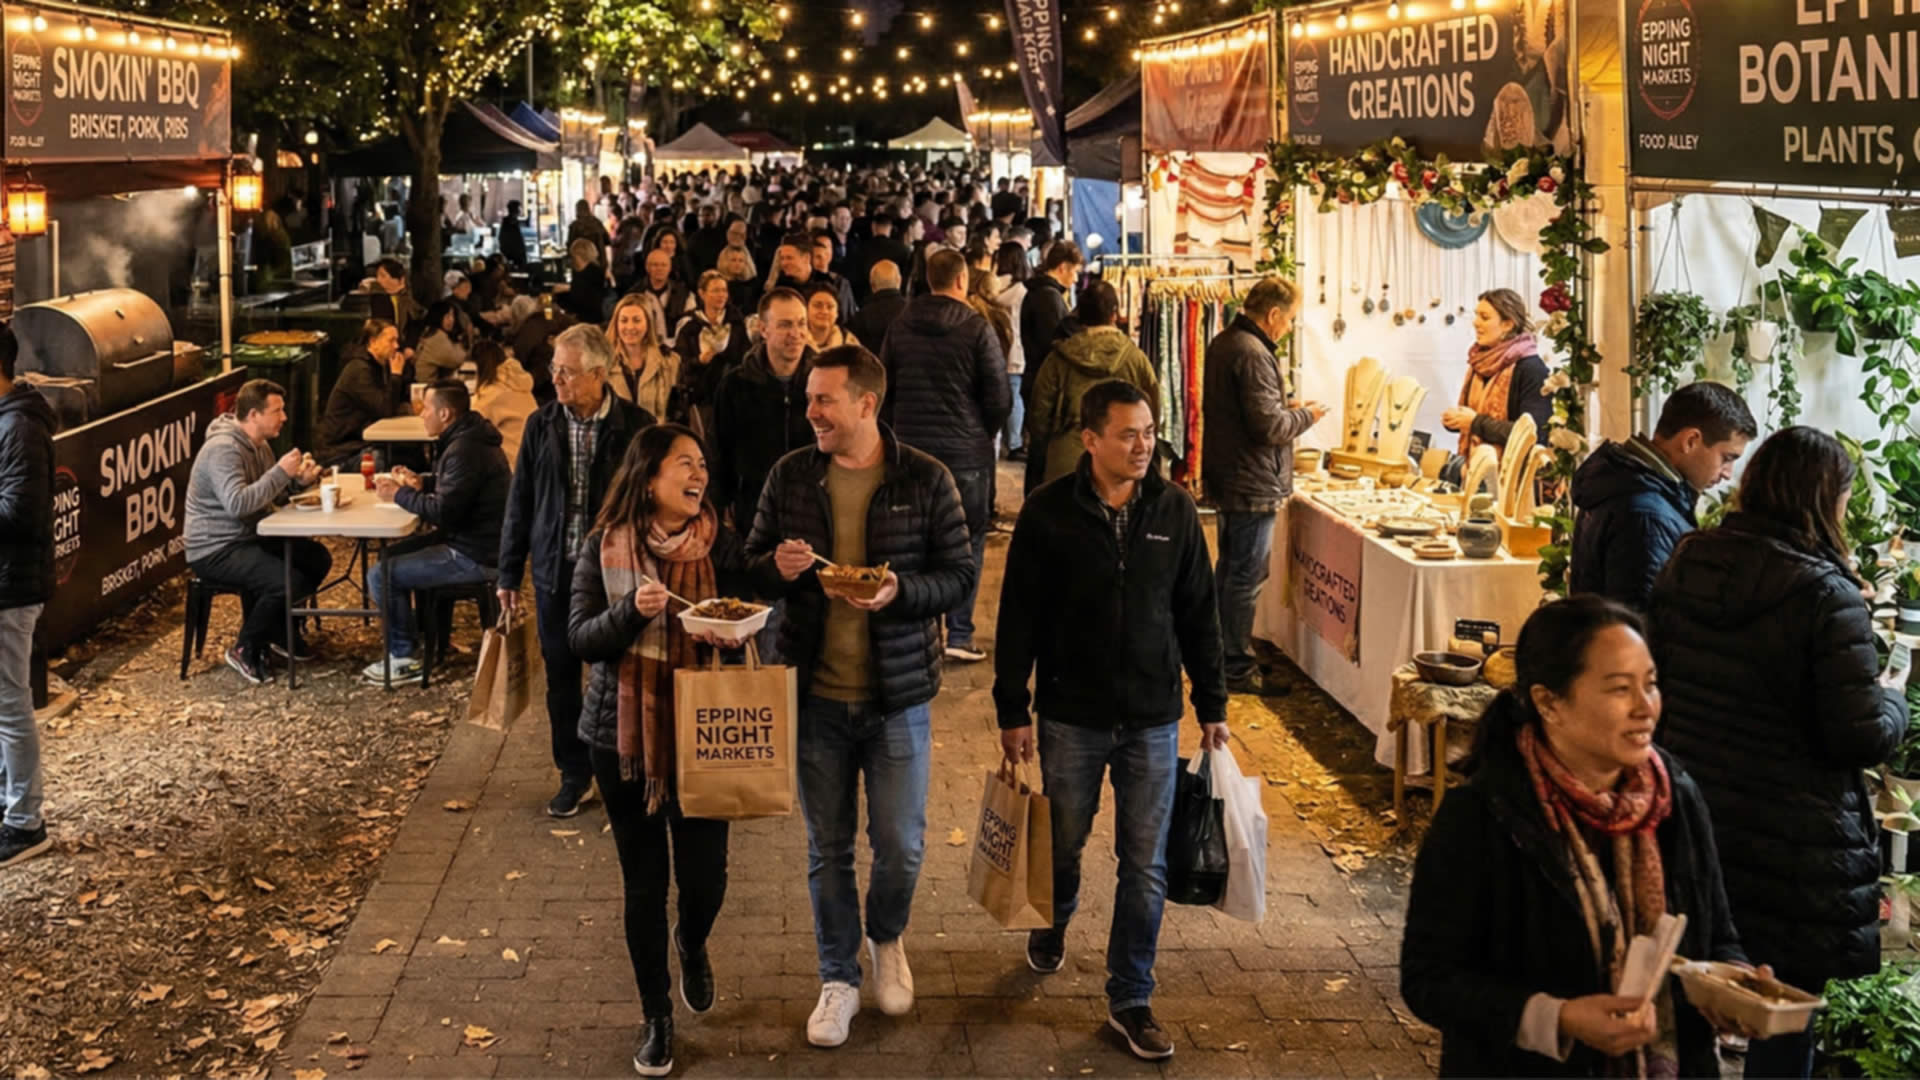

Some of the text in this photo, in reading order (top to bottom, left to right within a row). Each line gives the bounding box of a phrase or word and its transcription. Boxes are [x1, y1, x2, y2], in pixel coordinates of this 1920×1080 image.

[1329, 14, 1499, 76] HANDCRAFTED
[1641, 17, 1691, 42] EPPING
[1642, 41, 1691, 67] NIGHT
[1739, 30, 1918, 104] BOTANI
[53, 47, 201, 110] SMOKIN' BBQ
[1642, 68, 1692, 85] MARKETS
[1348, 70, 1475, 120] CREATIONS
[70, 113, 189, 143] BRISKET, PORK, RIBS
[1640, 133, 1699, 150] FOOD ALLEY
[1783, 124, 1904, 174] PLANTS,
[100, 411, 196, 498] SMOKIN'
[126, 477, 176, 543] BBQ
[696, 707, 773, 724] EPPING
[696, 726, 773, 744] NIGHT
[696, 746, 775, 760] MARKETS
[981, 822, 1015, 857] NIGHT
